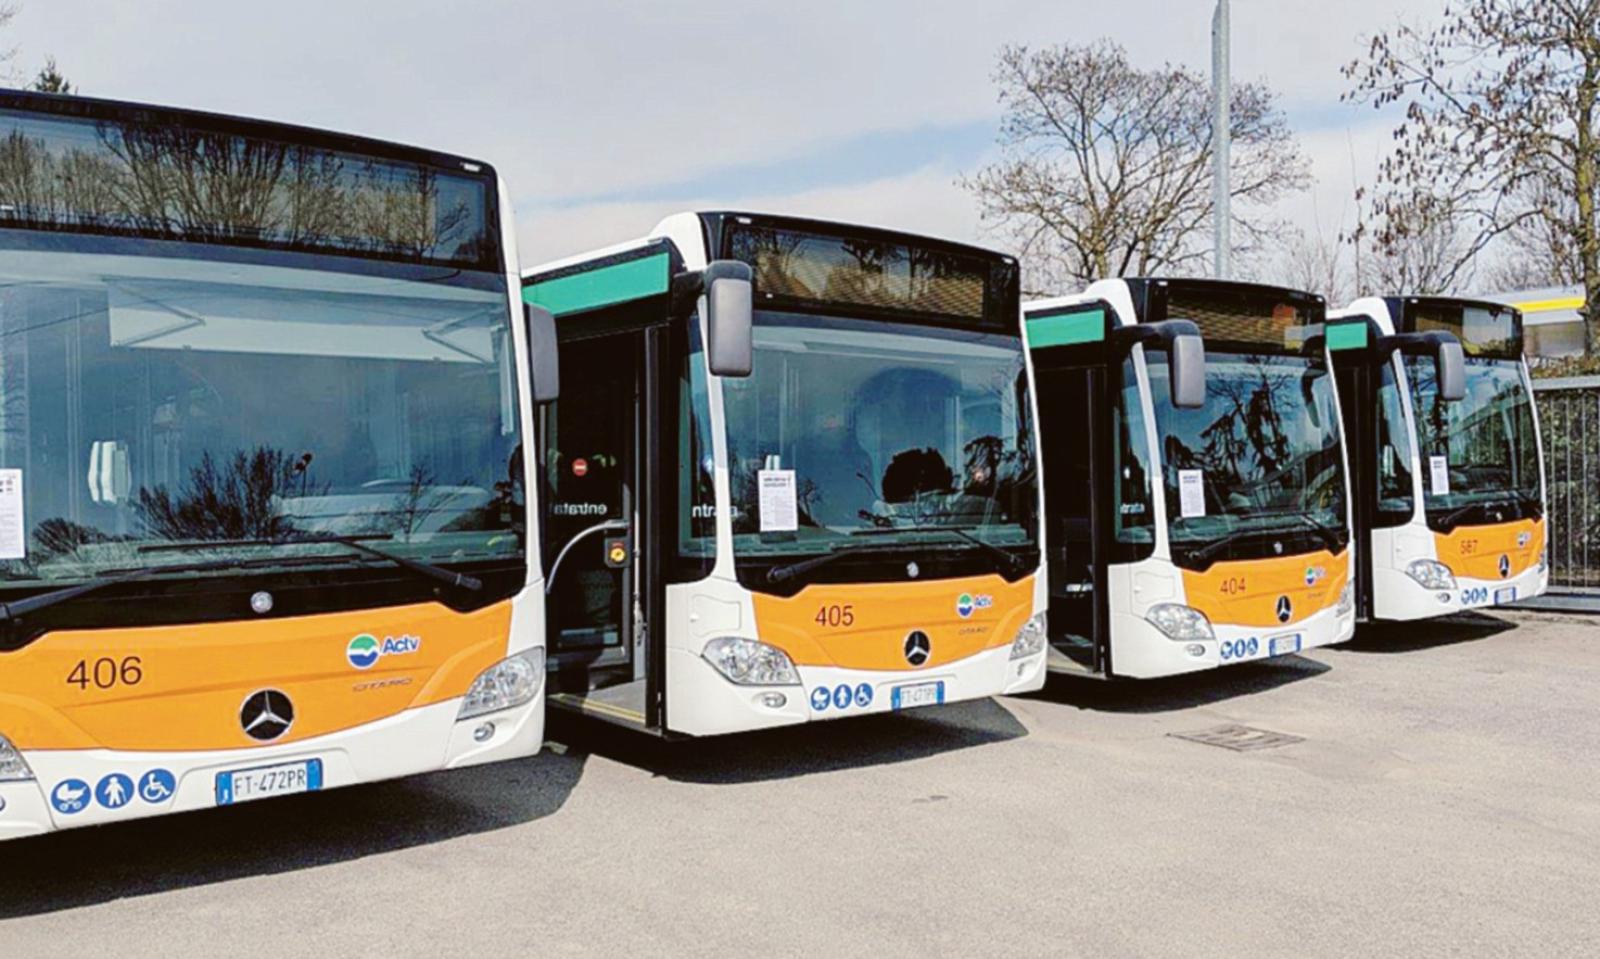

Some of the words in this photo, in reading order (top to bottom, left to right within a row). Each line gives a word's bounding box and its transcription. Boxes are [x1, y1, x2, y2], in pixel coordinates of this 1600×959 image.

[1220, 577, 1246, 595] 404
[814, 605, 854, 628] 405
[382, 636, 420, 654] Actv
[66, 656, 143, 690] 406
